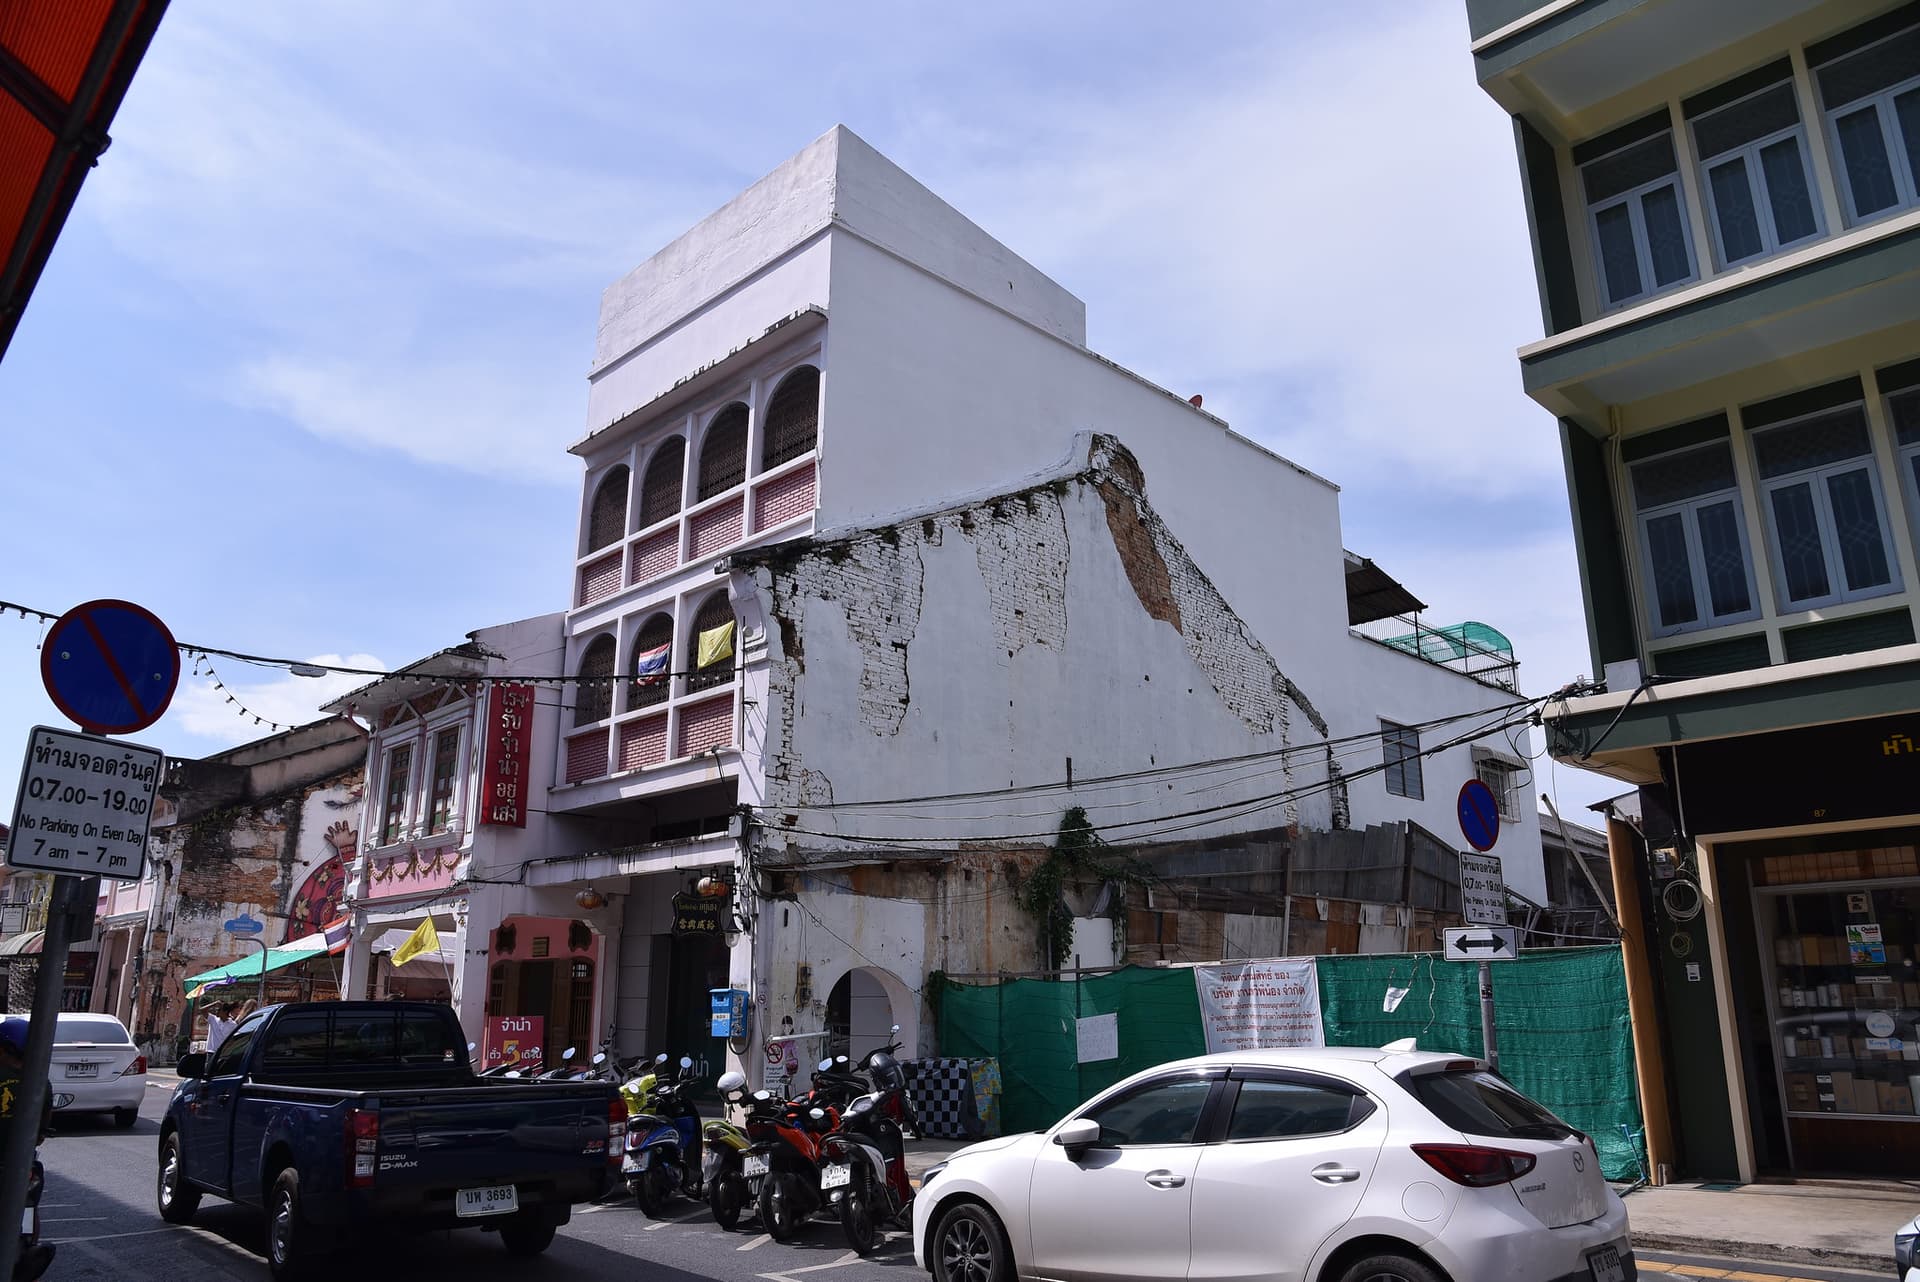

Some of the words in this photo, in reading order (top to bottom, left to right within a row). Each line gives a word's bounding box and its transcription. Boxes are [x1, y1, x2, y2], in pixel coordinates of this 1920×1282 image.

[35, 736, 155, 793] ห้ามจอดวันคู่
[20, 813, 36, 829] No
[40, 816, 79, 838] Parking
[83, 822, 98, 837] On
[102, 825, 124, 841] Even
[127, 827, 144, 846] Day
[33, 839, 46, 855] 7
[48, 847, 69, 860] am
[96, 846, 107, 864] 7
[109, 853, 128, 868] pm
[501, 1017, 531, 1032] จำนำ
[502, 1039, 520, 1066] 5
[379, 1160, 419, 1171] D-MAX
[380, 1153, 407, 1162] ISUZU
[486, 1188, 513, 1202] 3693
